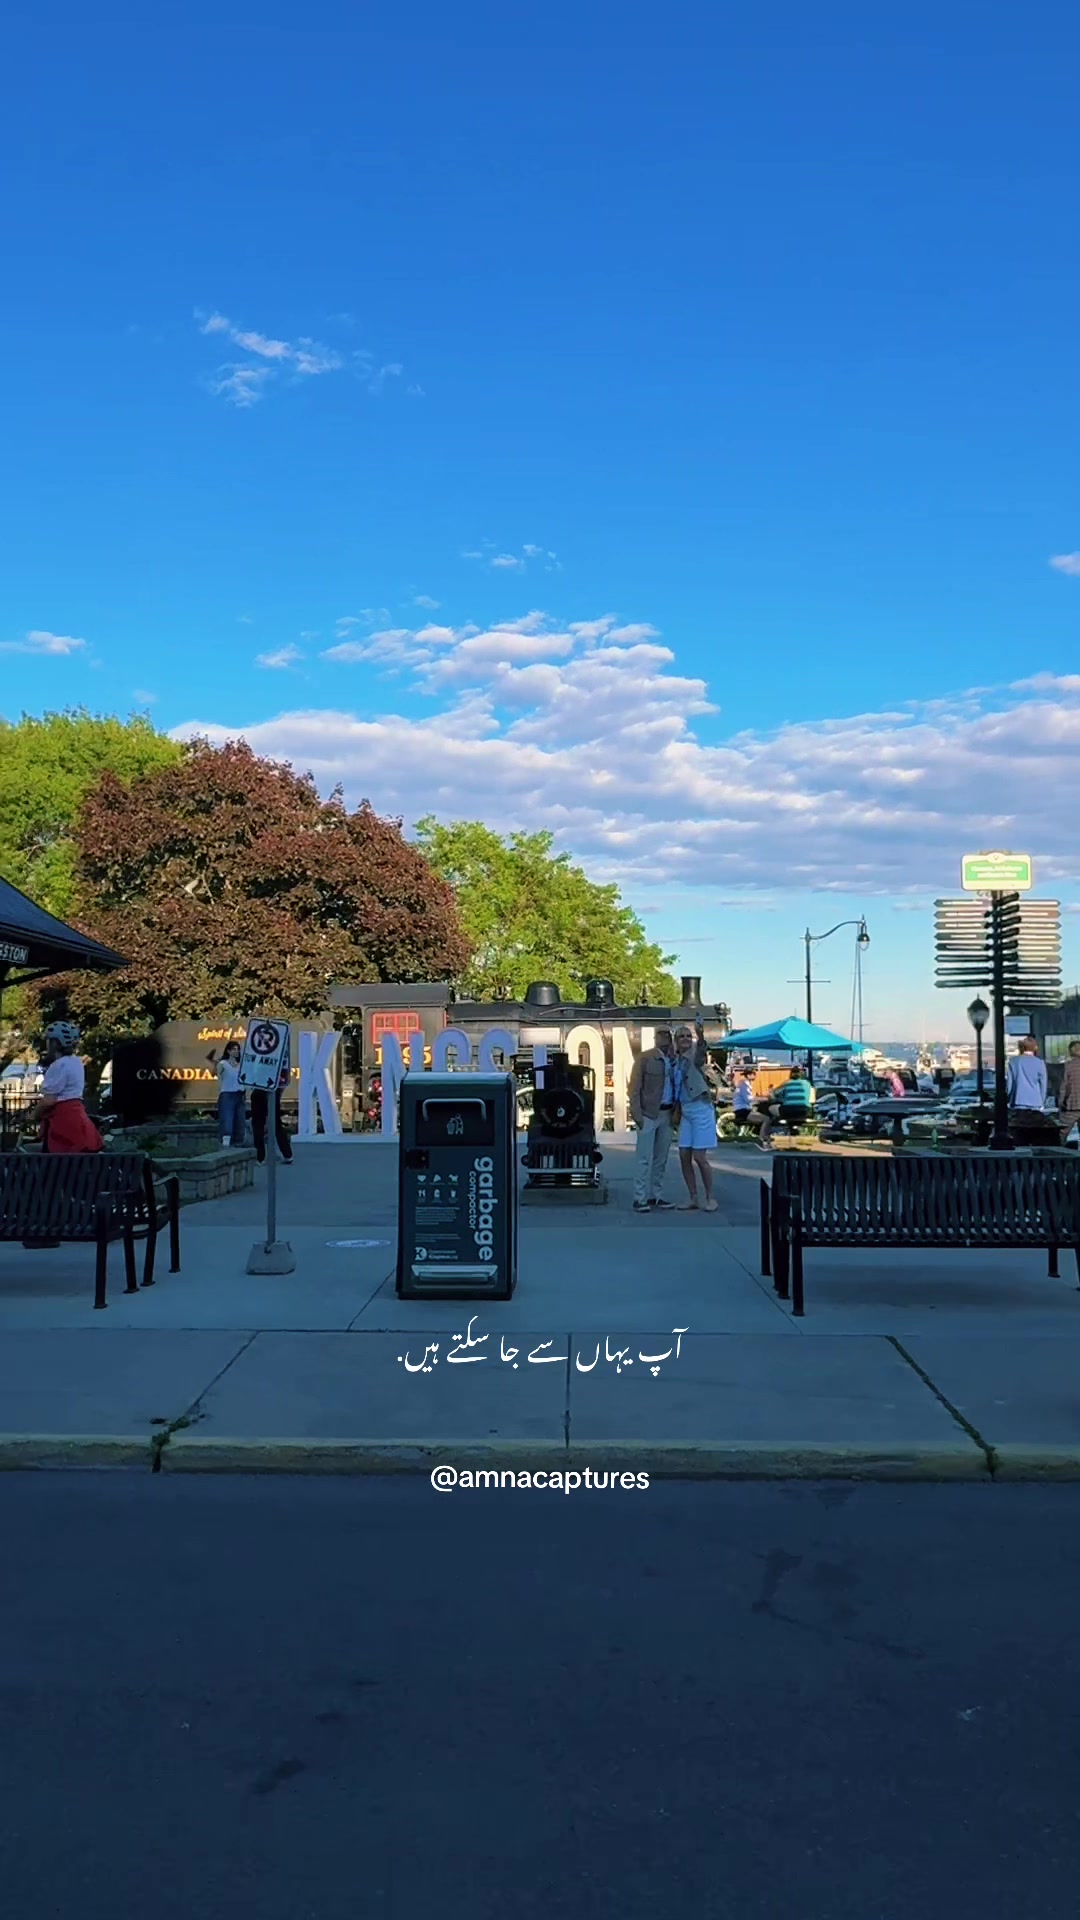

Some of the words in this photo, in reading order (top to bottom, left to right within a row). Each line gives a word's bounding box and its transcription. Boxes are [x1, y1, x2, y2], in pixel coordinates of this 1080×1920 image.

[136, 1067, 219, 1081] CANADIA
[244, 1053, 257, 1063] TOW
[258, 1055, 279, 1066] AWAY
[467, 1170, 477, 1230] compactor
[474, 1156, 498, 1261] garbage
